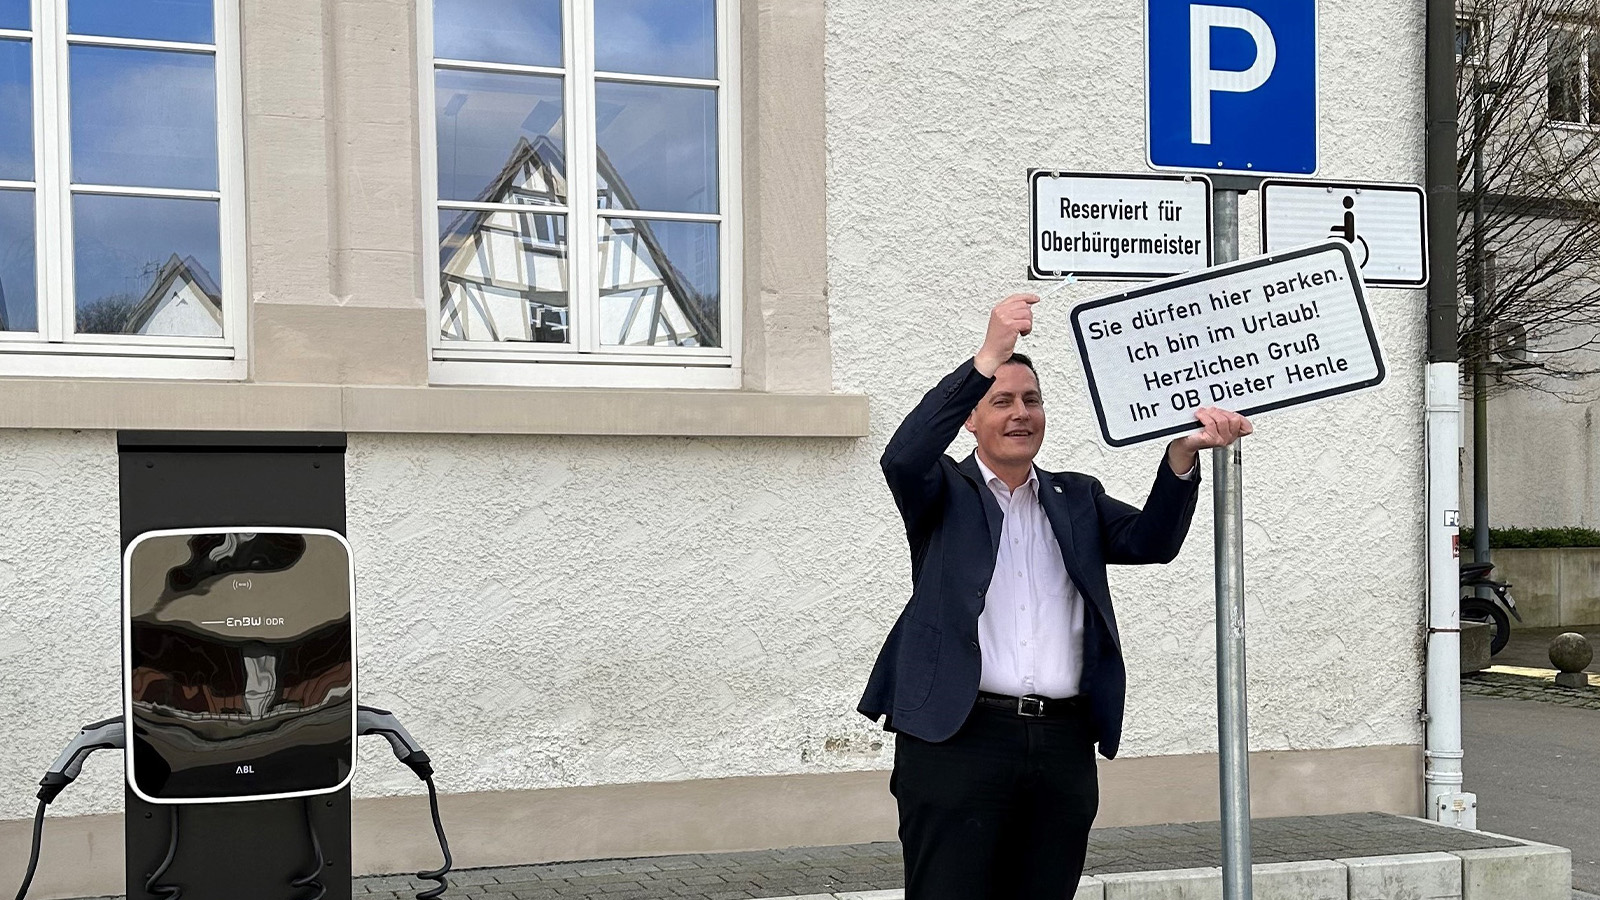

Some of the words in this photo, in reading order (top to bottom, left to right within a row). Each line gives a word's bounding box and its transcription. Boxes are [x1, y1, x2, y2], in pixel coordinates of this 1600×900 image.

[1190, 4, 1277, 145] P
[1060, 197, 1148, 221] Reserviert
[1158, 200, 1182, 222] für
[1041, 230, 1201, 259] Oberbürgermeister
[1088, 320, 1123, 340] Sie
[1131, 301, 1202, 331] dürfen
[1209, 287, 1252, 311] hier
[1263, 268, 1344, 302] parken.
[1126, 342, 1159, 363] Ich
[1166, 332, 1200, 354] bin
[1207, 325, 1235, 344] im
[1241, 300, 1321, 334] Urlaub!
[1129, 401, 1160, 422] Ihr
[1171, 389, 1201, 412] OB
[1209, 372, 1275, 402] Dieter
[1285, 356, 1349, 384] Henle
[1143, 349, 1259, 391] Herzlichen
[1268, 332, 1321, 360] Gruß
[226, 616, 262, 627] EnBW
[265, 617, 285, 626] ODR
[235, 765, 255, 774] ABL
